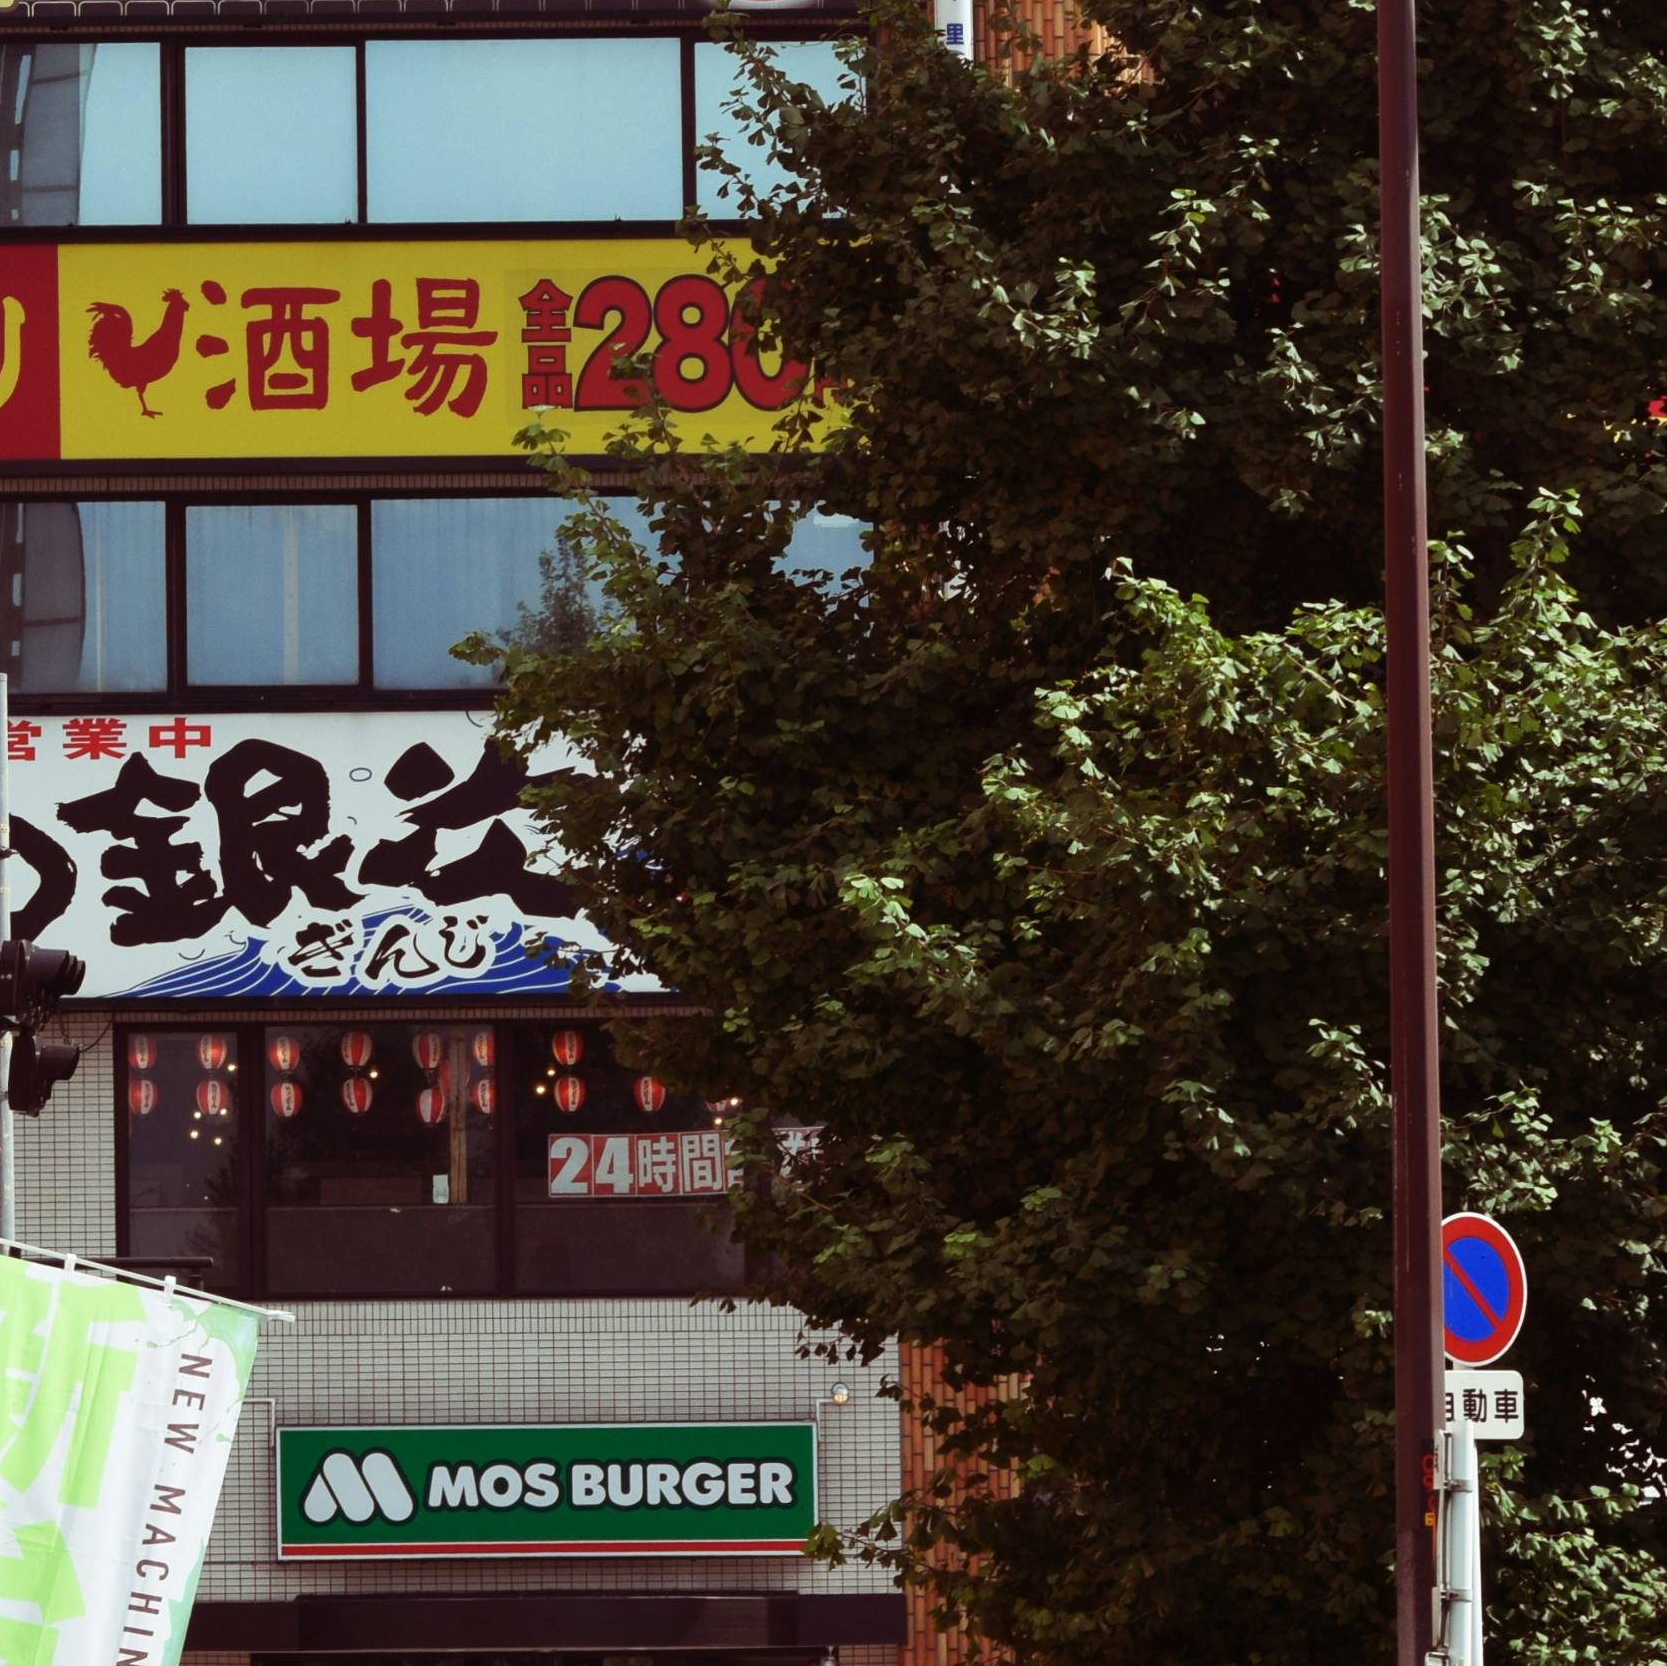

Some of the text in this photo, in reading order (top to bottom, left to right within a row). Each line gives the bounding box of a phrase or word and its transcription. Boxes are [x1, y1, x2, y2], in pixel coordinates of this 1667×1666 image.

[202, 277, 498, 418] 酒場
[518, 279, 573, 410] 全品
[291, 914, 491, 981] ぎんじ
[162, 1352, 213, 1455] NEW
[428, 1461, 794, 1509] MOS BURGER
